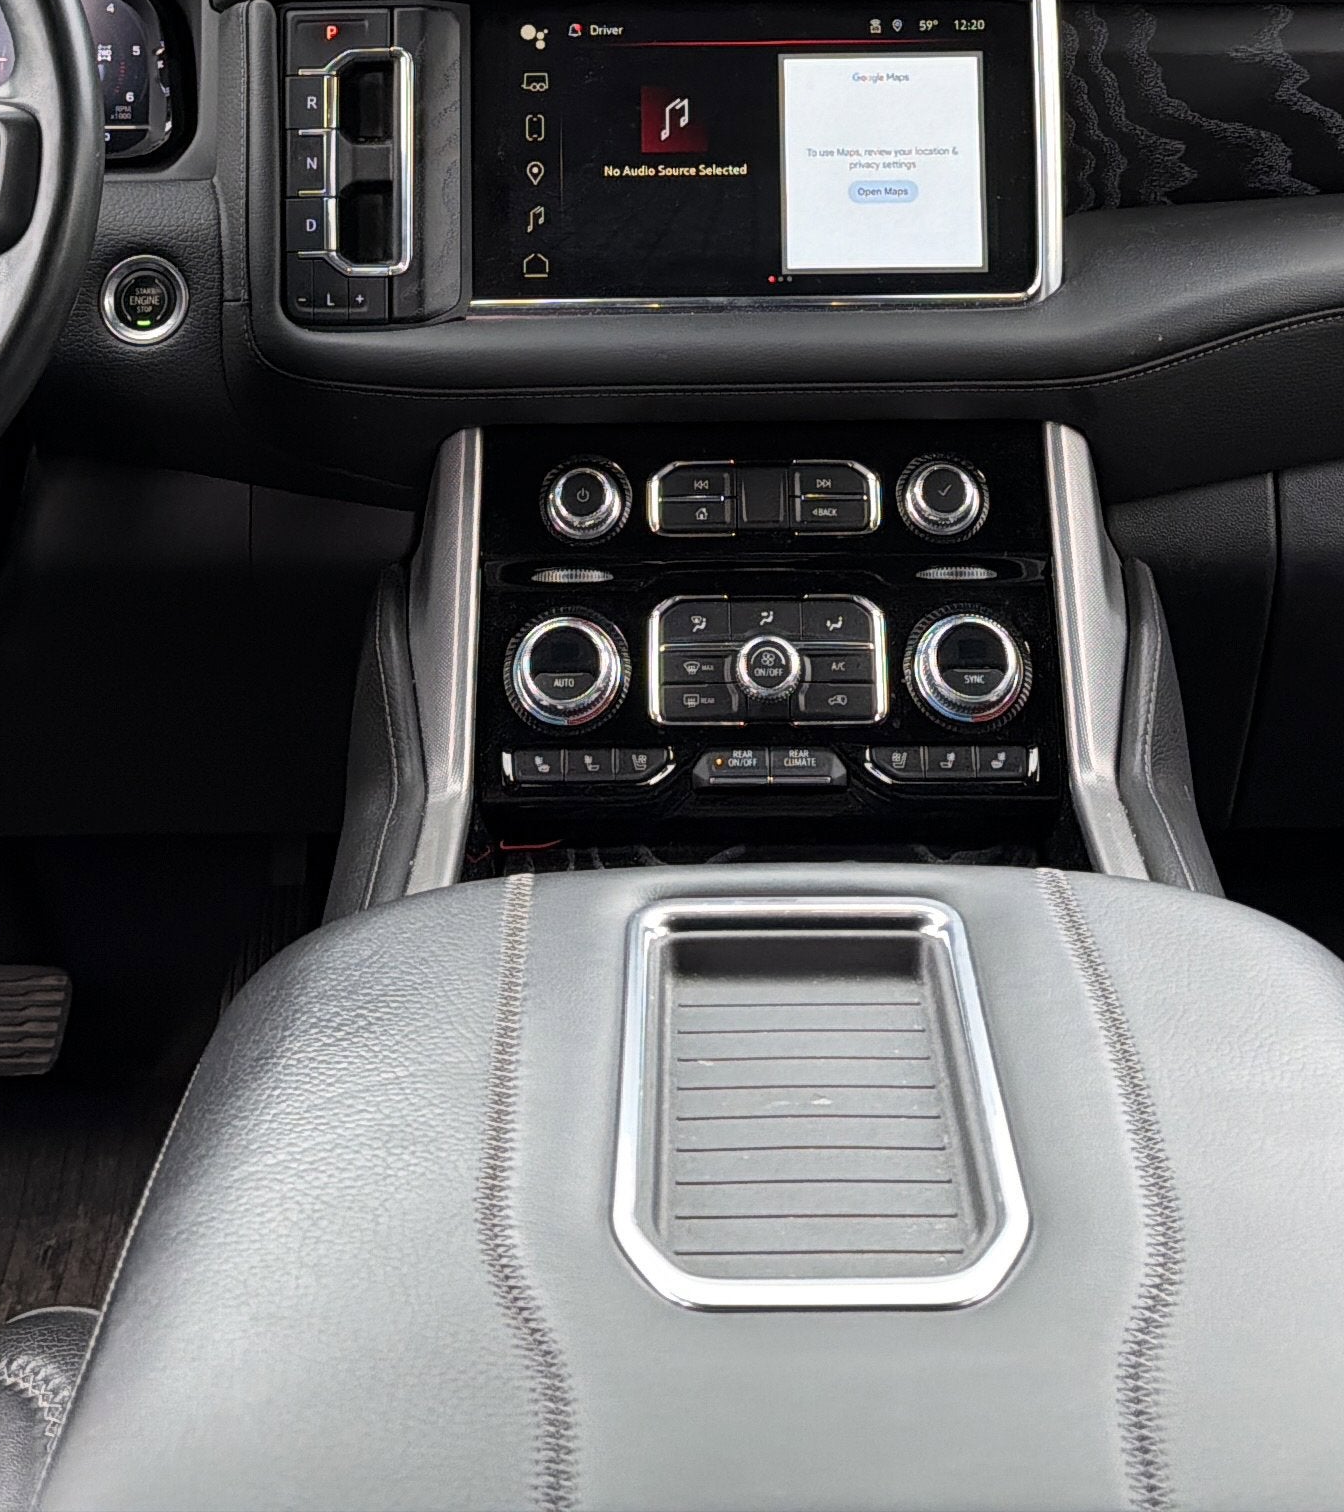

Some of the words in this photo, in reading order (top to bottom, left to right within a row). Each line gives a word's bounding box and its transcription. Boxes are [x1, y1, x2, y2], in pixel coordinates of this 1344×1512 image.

[106, 2, 115, 13] 4
[590, 24, 624, 35] Driver
[954, 20, 985, 30] 12:20
[326, 26, 338, 39] P
[132, 45, 141, 56] 5
[852, 72, 885, 84] Google
[886, 73, 910, 83] Maps
[125, 91, 135, 102] 6
[306, 96, 317, 109] R
[115, 105, 132, 113] RPM
[807, 148, 817, 157] To
[864, 148, 892, 156] review
[894, 149, 913, 158] your
[914, 147, 949, 156] location
[951, 147, 959, 156] &
[306, 157, 318, 170] N
[849, 160, 880, 171] privacy
[882, 160, 917, 170] settings
[604, 165, 620, 176] No
[622, 165, 656, 176] Audio
[658, 164, 697, 176] Source
[698, 163, 748, 176] Selected
[858, 187, 882, 197] Open
[884, 186, 909, 197] Maps
[306, 219, 317, 232] D
[129, 295, 160, 305] ENGINE
[327, 294, 335, 306] L
[137, 305, 153, 313] STOP
[818, 508, 838, 517] BACK
[831, 662, 846, 671] A/C
[754, 668, 783, 677] ON/OFF
[554, 678, 575, 687] AUTO
[964, 674, 985, 684] SYNC
[733, 750, 753, 758] REAR
[789, 749, 809, 758] REAR
[728, 757, 757, 767] ON/OFF
[784, 757, 817, 767] CLIMATE
